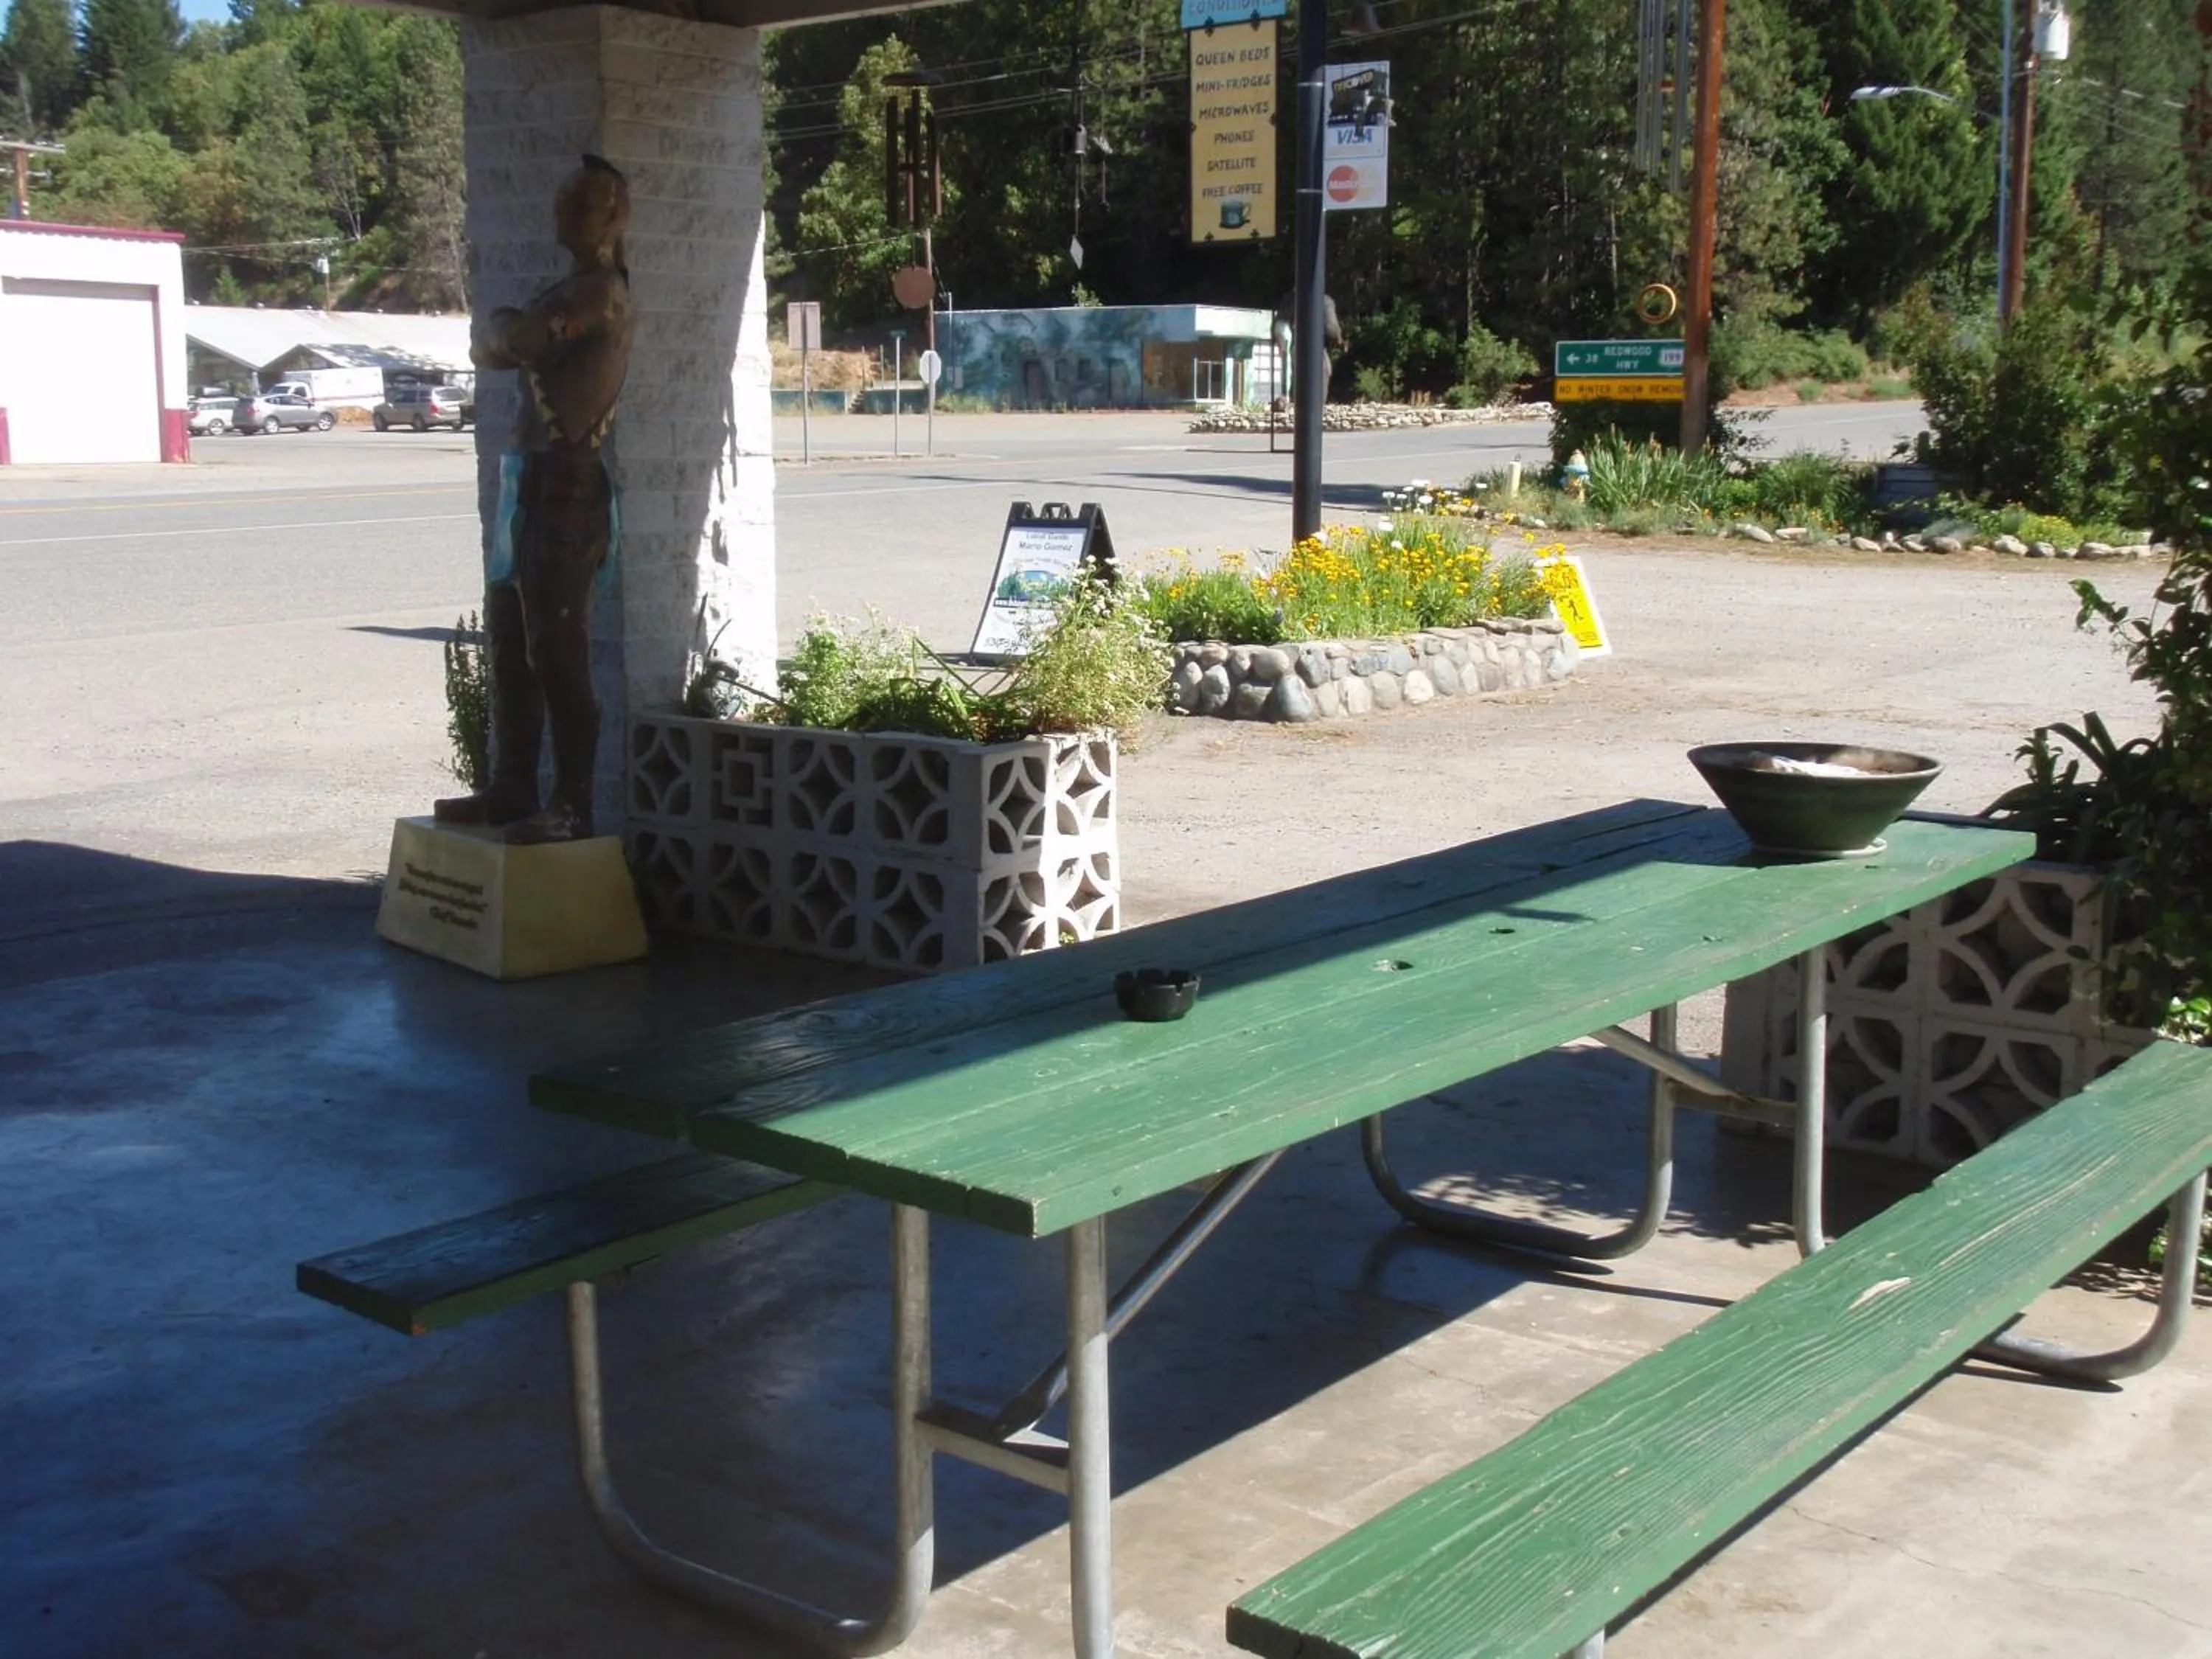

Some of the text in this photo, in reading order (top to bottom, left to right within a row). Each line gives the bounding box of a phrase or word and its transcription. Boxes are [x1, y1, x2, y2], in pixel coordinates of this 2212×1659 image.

[1195, 46, 1270, 66] QUEEN BEDS
[1196, 74, 1271, 93] MINI-FRIDGES
[1199, 101, 1269, 119] MICROWAVES
[1214, 130, 1255, 144] PHONES
[1207, 157, 1256, 171] SATELLITE
[1202, 183, 1263, 198] FREE COFFEE
[1604, 347, 1652, 356] REDWOOD
[1664, 350, 1682, 362] 199
[1615, 360, 1640, 369] HWY
[1559, 385, 1571, 394] NO
[1578, 384, 1611, 394] WINTER
[1618, 385, 1644, 394] SNOW
